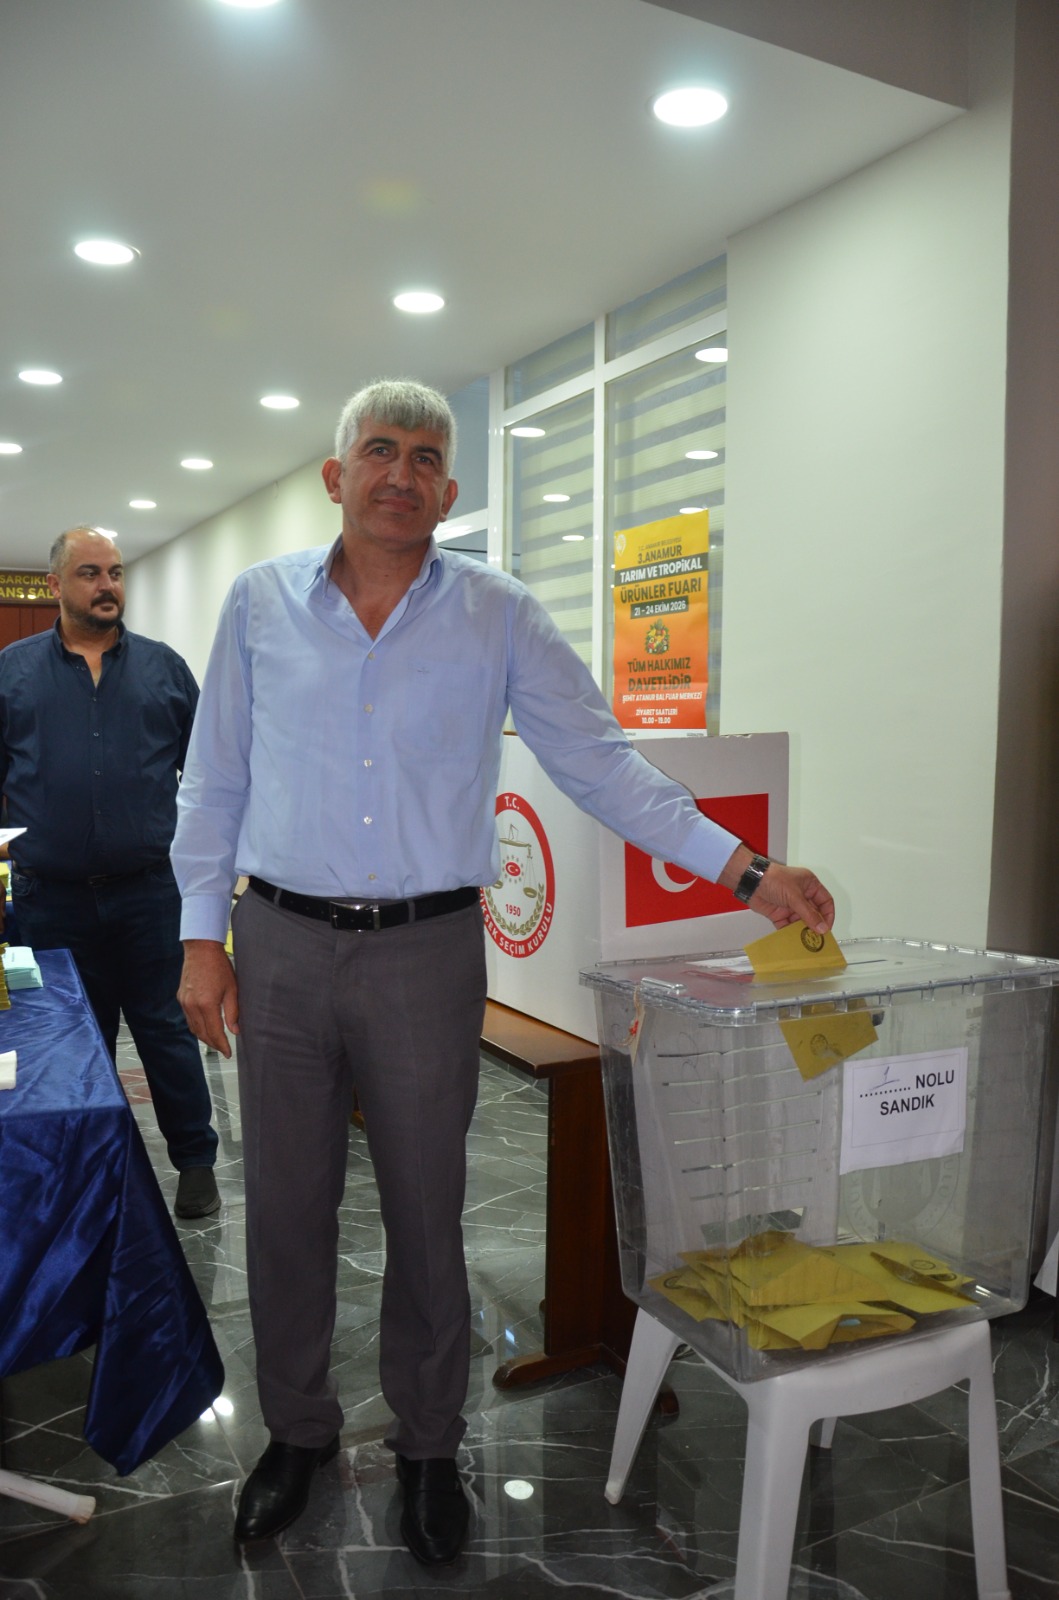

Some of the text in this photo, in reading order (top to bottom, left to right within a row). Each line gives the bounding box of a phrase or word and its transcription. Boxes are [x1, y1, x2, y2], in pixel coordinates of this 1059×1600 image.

[638, 545, 682, 564] 3.ANAMUR
[620, 567, 646, 583] TARIM
[647, 566, 658, 578] VE
[620, 577, 701, 604] ÜRÜNLER FUARI
[645, 605, 654, 615] 24
[654, 601, 670, 613] EKİM
[670, 600, 686, 611] 2026
[627, 657, 691, 673] TÜM HALKIMIZ
[504, 796, 520, 810] T.C.
[505, 904, 521, 917] 1950
[499, 937, 525, 957] SEÇİM
[527, 903, 552, 951] KURULU
[916, 1069, 955, 1089] NOLU
[880, 1093, 935, 1116] SANDIK
